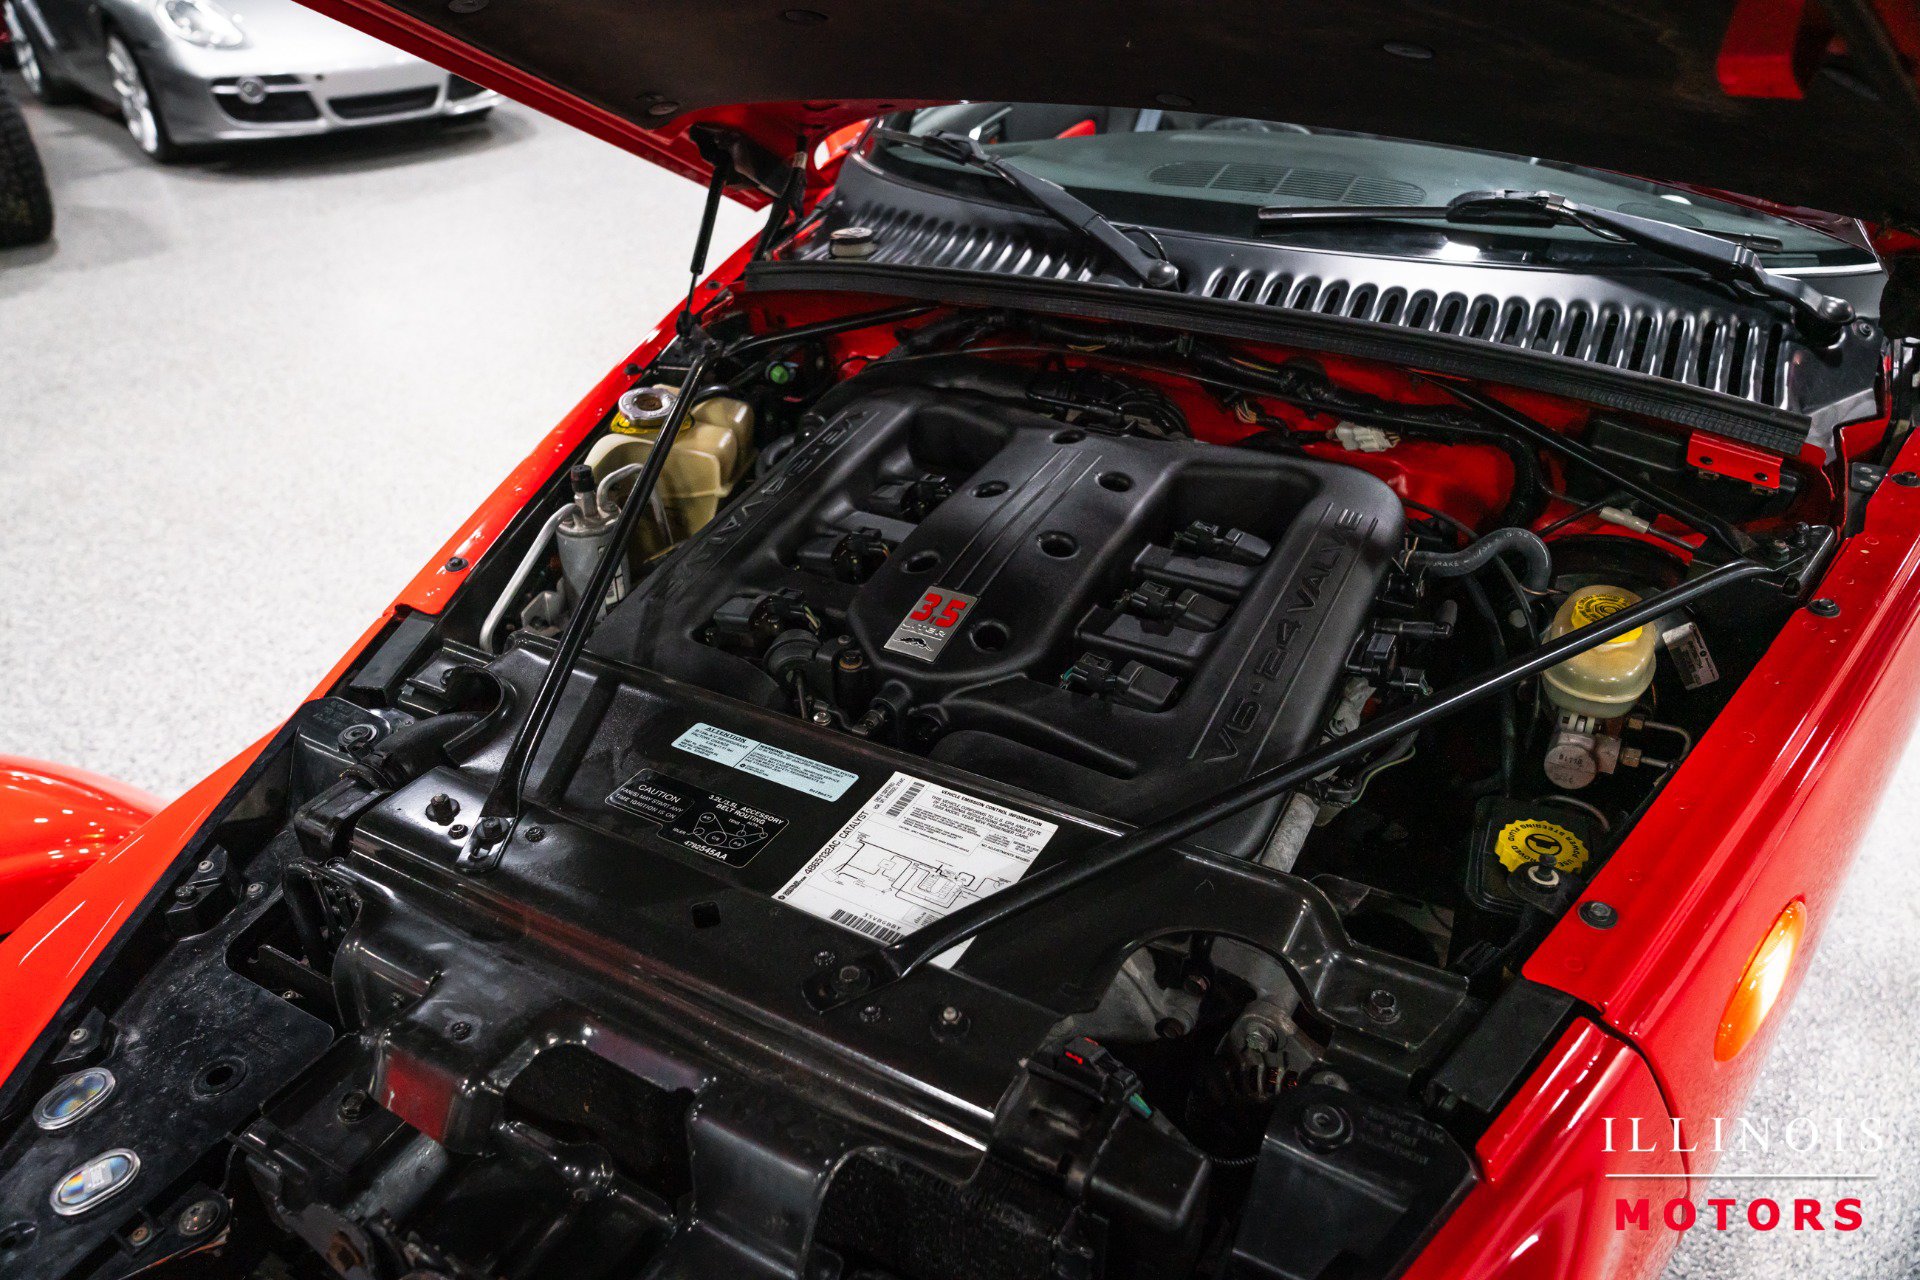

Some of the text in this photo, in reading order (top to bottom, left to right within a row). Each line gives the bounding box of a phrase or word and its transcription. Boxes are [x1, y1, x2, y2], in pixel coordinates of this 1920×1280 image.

[1286, 507, 1364, 611] VALVE
[910, 593, 967, 628] 3.5
[903, 623, 946, 637] LITER
[704, 726, 748, 743] ATTENTION
[614, 793, 631, 802] TIME
[629, 799, 659, 812] IGNITION
[619, 787, 684, 813] FAN(S) MAY START ANY
[636, 784, 682, 803] CAUTION
[715, 804, 767, 825] BELT ROUTING
[739, 806, 785, 825] ACCESSORY
[940, 790, 1043, 827] VEHICLE EMISSION CONTROL INFORMATION
[837, 810, 870, 839] CATALYST
[1026, 828, 1042, 836] STATE
[1520, 824, 1566, 836] STEERING
